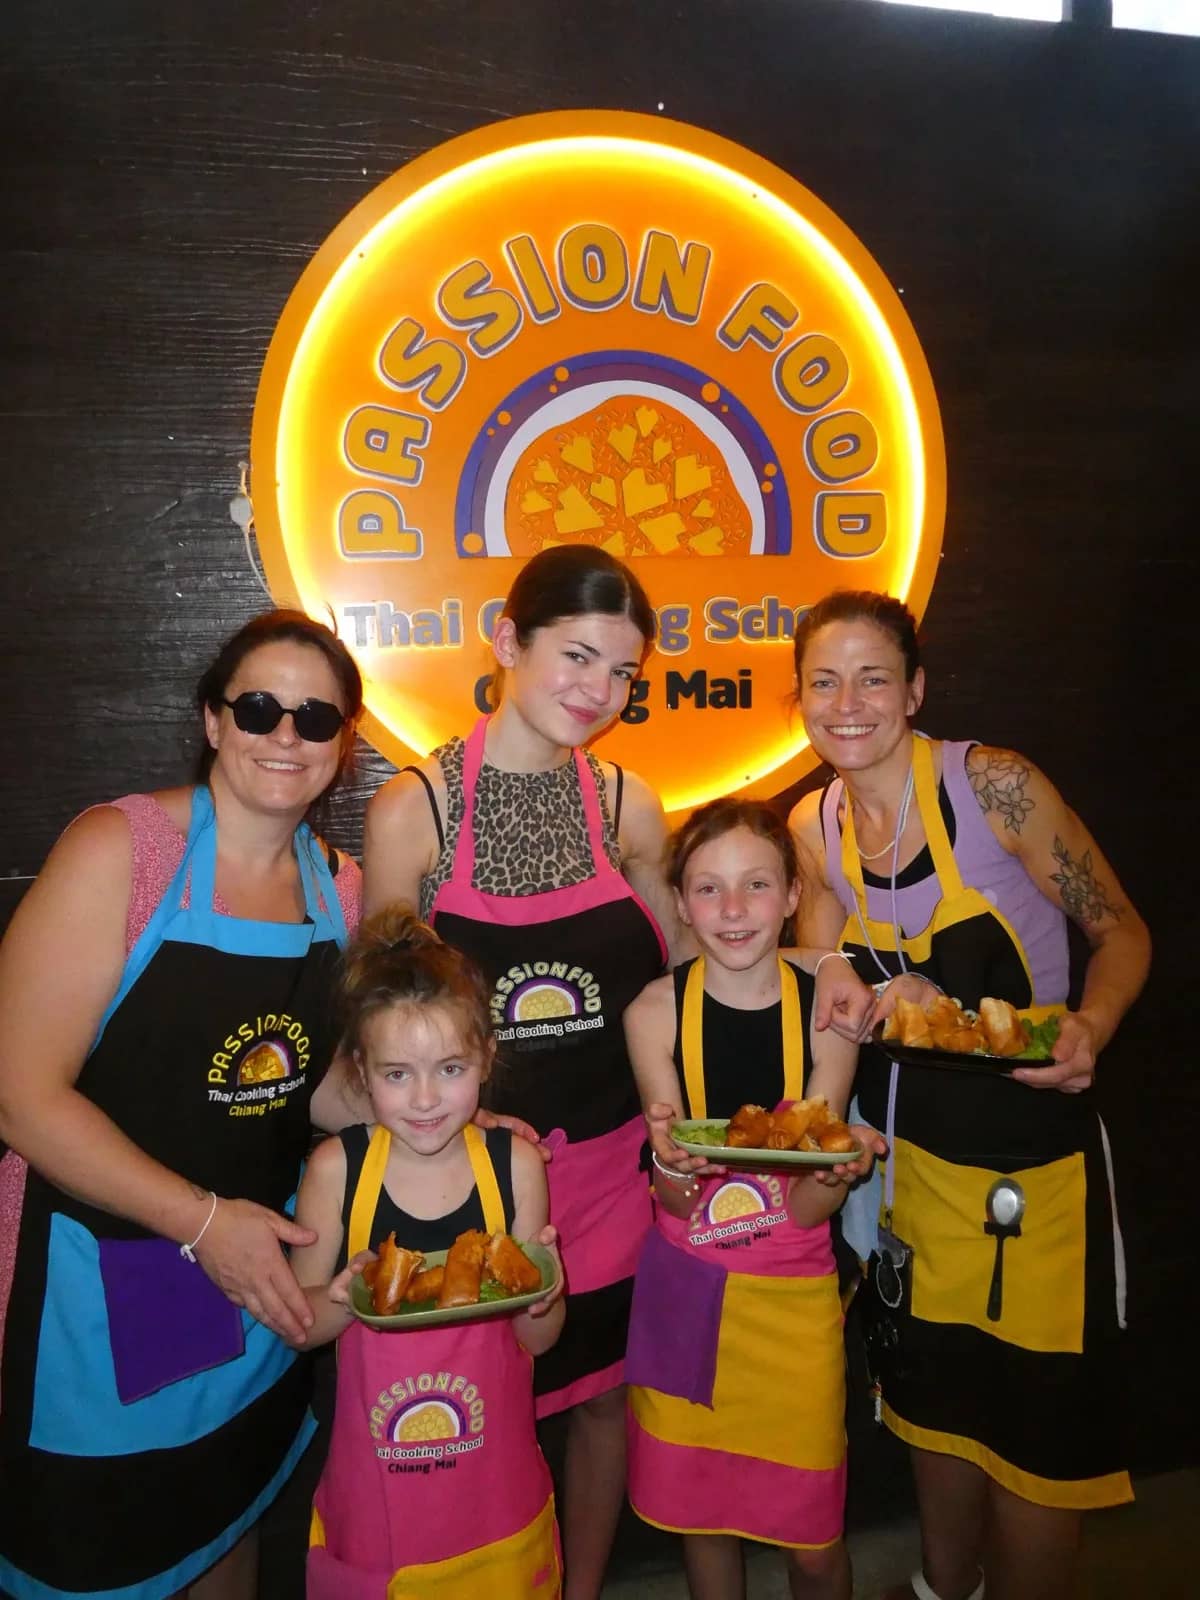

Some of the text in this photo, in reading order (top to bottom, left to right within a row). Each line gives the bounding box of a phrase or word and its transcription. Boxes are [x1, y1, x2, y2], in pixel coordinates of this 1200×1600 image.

[339, 223, 888, 560] PASSION FOOD
[343, 599, 464, 648] Thai
[704, 596, 812, 643] Sch
[665, 669, 753, 710] Mai
[495, 1015, 605, 1041] hai Cooking School
[208, 1090, 234, 1103] Thai
[234, 1086, 276, 1102] Cooking
[229, 1096, 287, 1117] Chiang Mai
[689, 1209, 788, 1247] Thai Cooking School
[392, 1446, 443, 1460] Cooking
[444, 1435, 485, 1455] School
[387, 1458, 457, 1474] Chiang Mai
